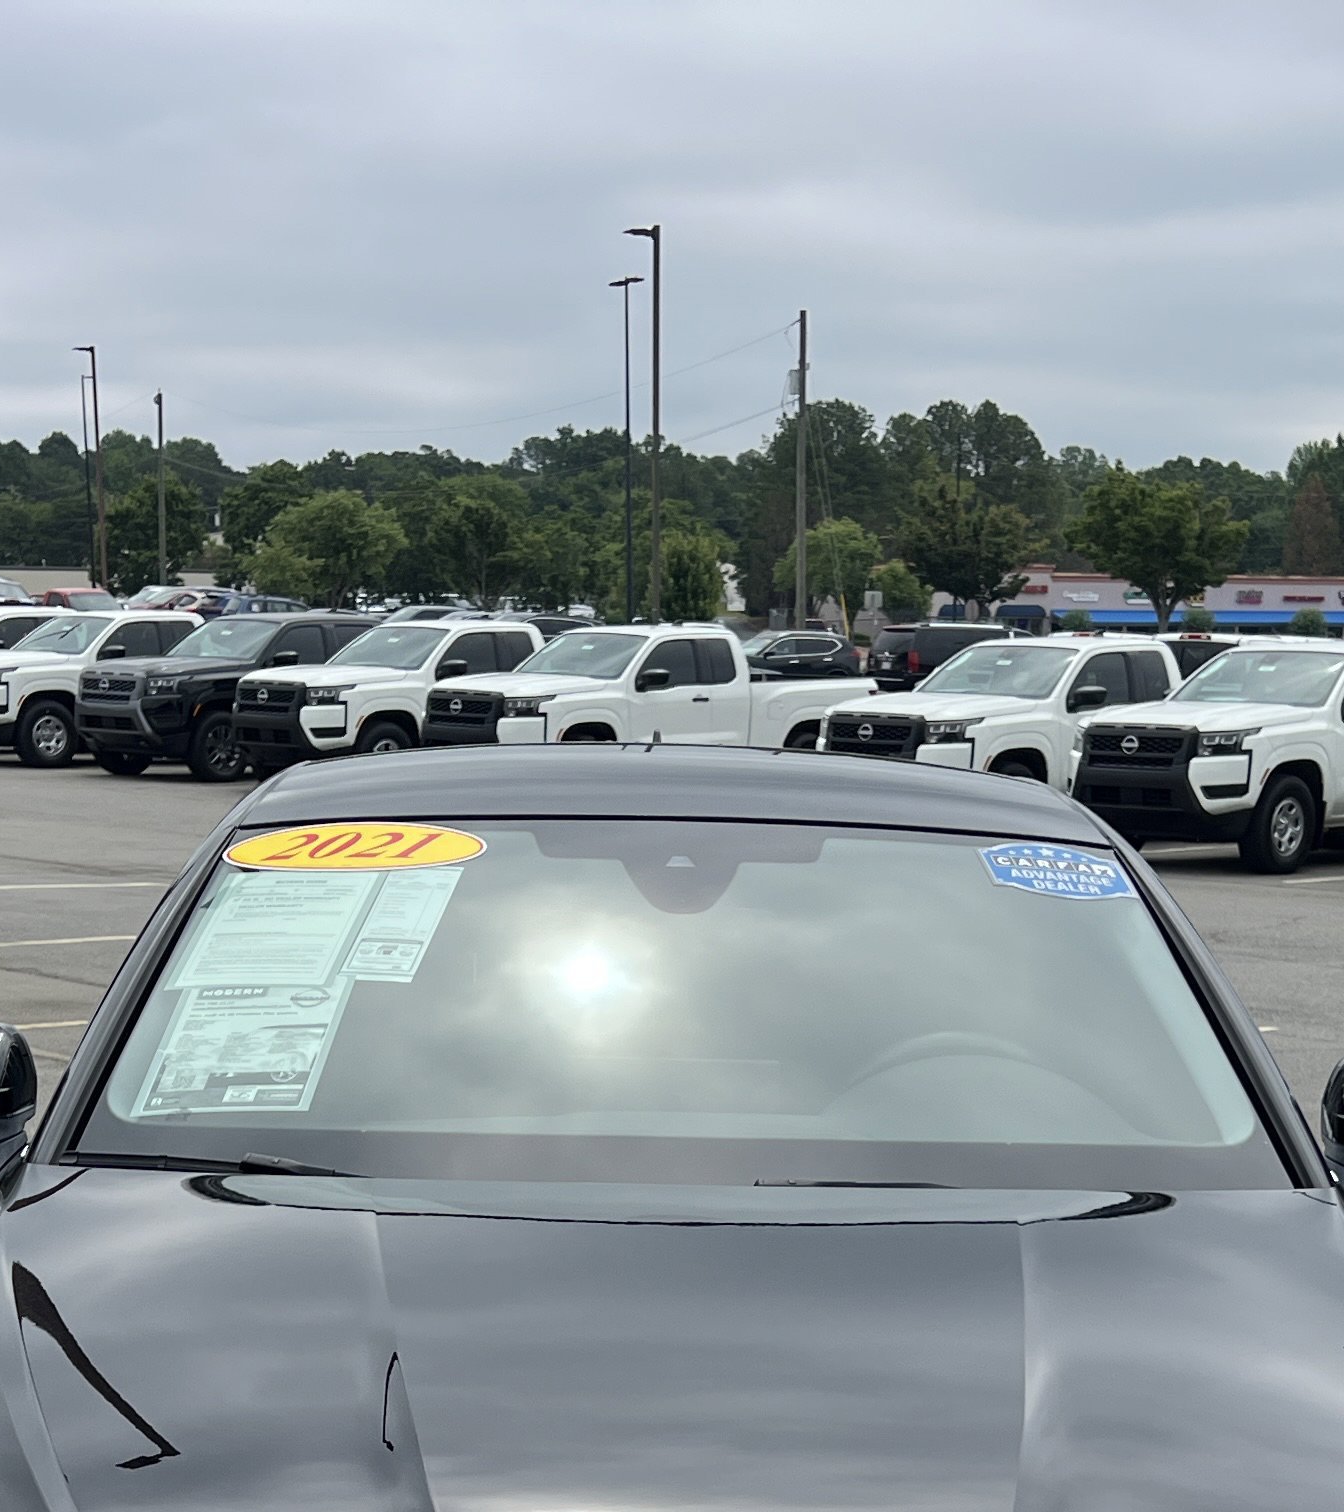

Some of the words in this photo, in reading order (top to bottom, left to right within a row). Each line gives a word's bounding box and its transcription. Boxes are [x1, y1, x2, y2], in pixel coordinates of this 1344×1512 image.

[261, 832, 444, 861] 2021
[996, 856, 1116, 878] CARFAX
[1010, 868, 1113, 887] ADVANTAGE
[1033, 880, 1102, 895] DEALER
[202, 988, 264, 997] MODERN
